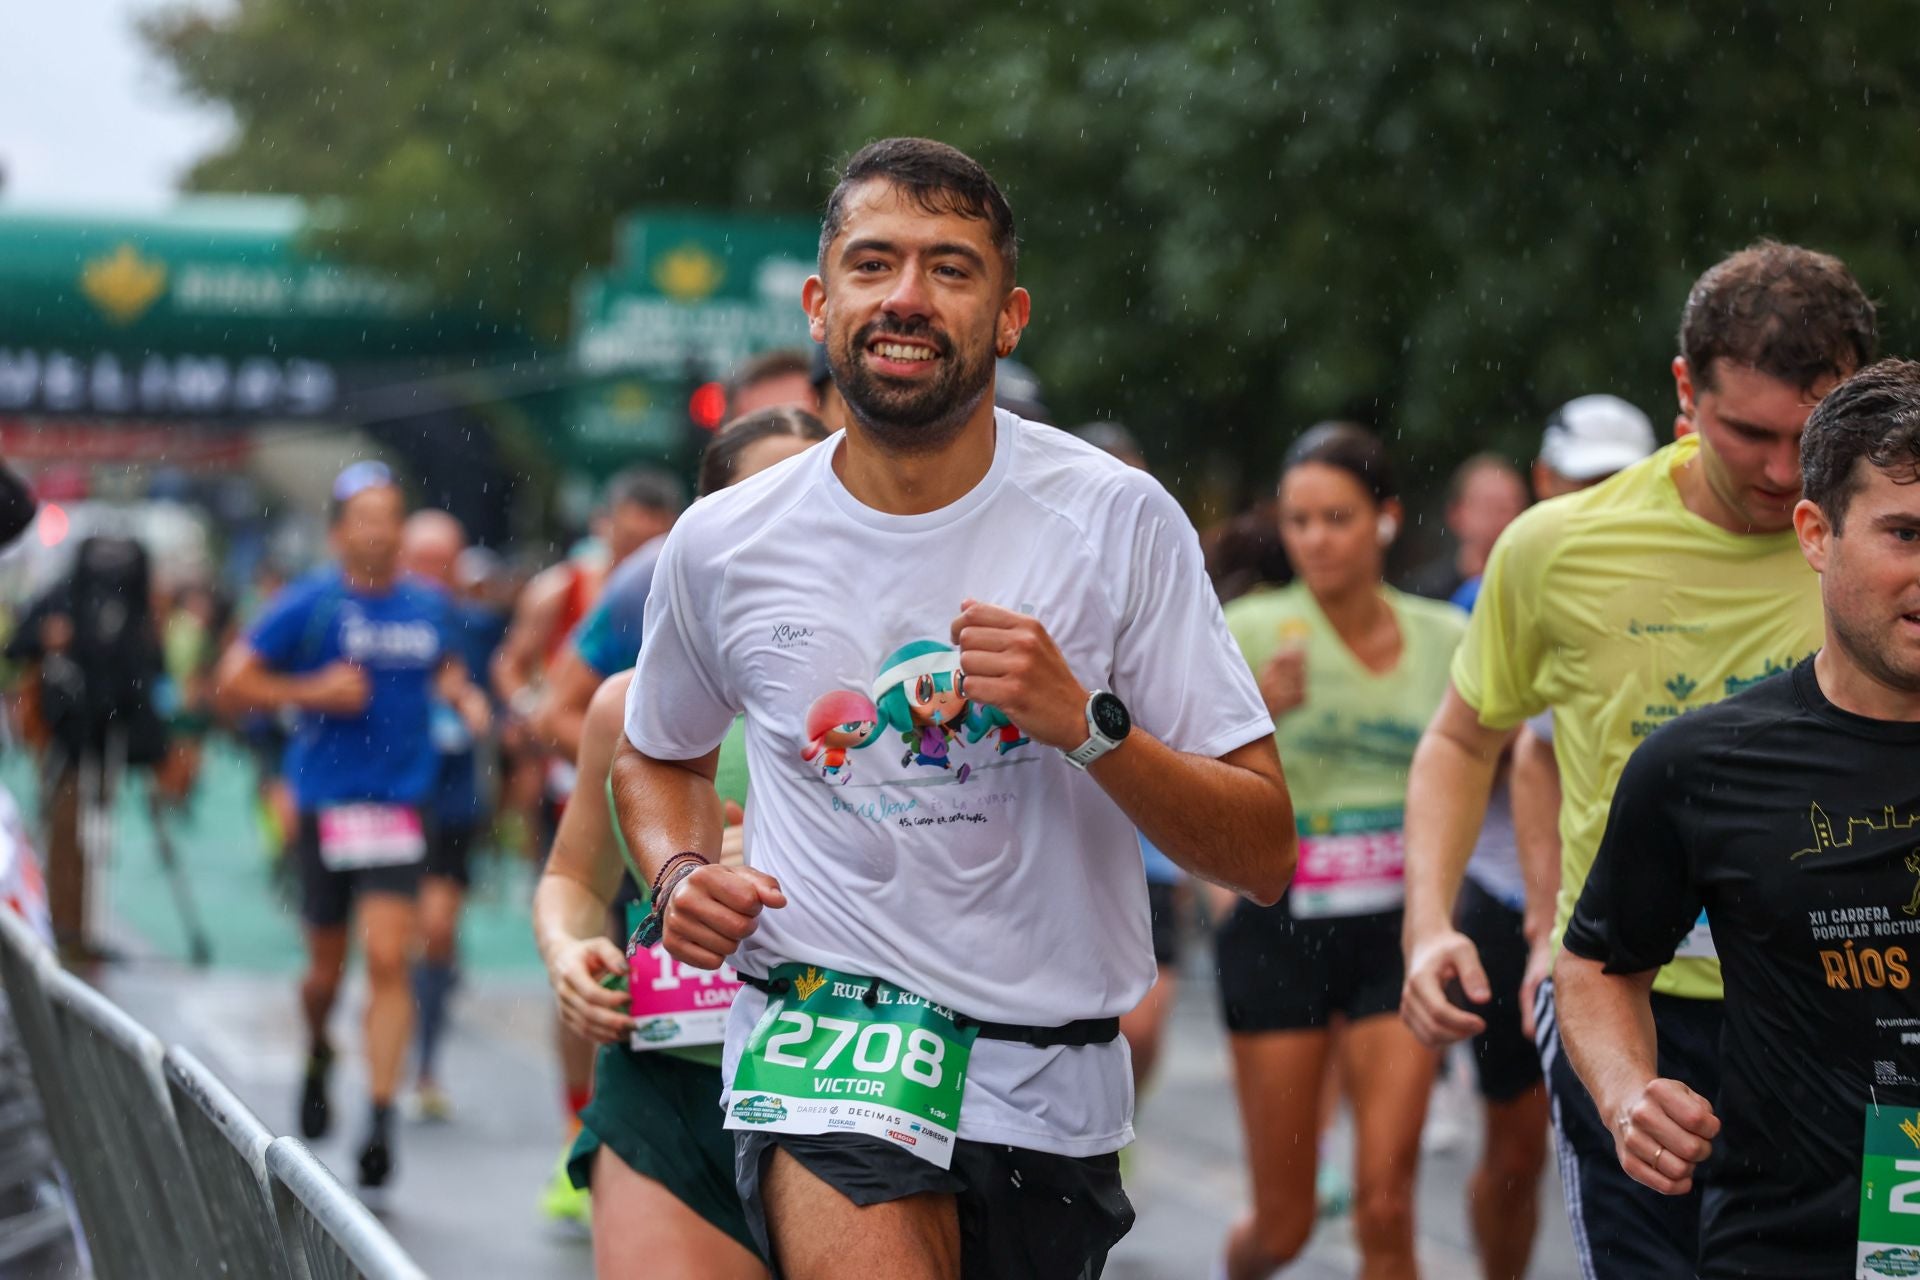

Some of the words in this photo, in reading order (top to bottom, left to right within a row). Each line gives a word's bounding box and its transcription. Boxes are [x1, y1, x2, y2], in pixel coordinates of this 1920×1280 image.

[1808, 910, 1828, 926] XII
[1831, 905, 1891, 925] CARRERA
[1811, 923, 1870, 941] POPULAR
[1819, 939, 1911, 990] RÍOS
[763, 1010, 946, 1088] 2708
[813, 1077, 886, 1097] VICTOR
[848, 1107, 902, 1125] DECIMAS
[921, 1127, 949, 1144] ZUBIEDER
